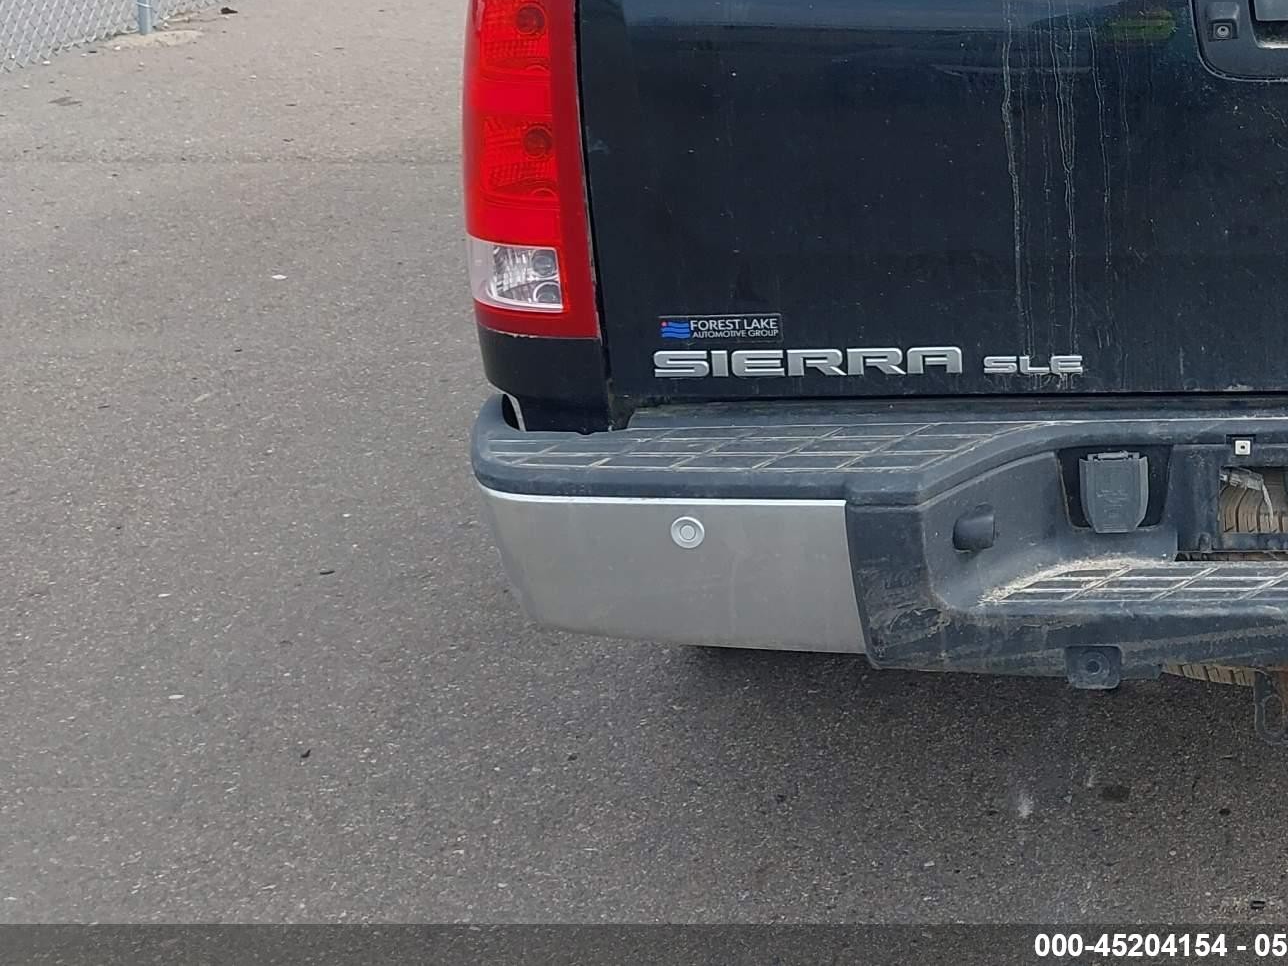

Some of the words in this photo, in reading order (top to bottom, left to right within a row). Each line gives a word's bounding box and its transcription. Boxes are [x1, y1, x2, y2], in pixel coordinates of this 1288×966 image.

[690, 319, 740, 330] FOREST
[744, 318, 778, 330] LAKE
[692, 329, 745, 338] AUTOMOTIVE
[747, 329, 779, 337] GROUP
[653, 346, 963, 378] SIERRA
[983, 355, 1084, 374] SLE
